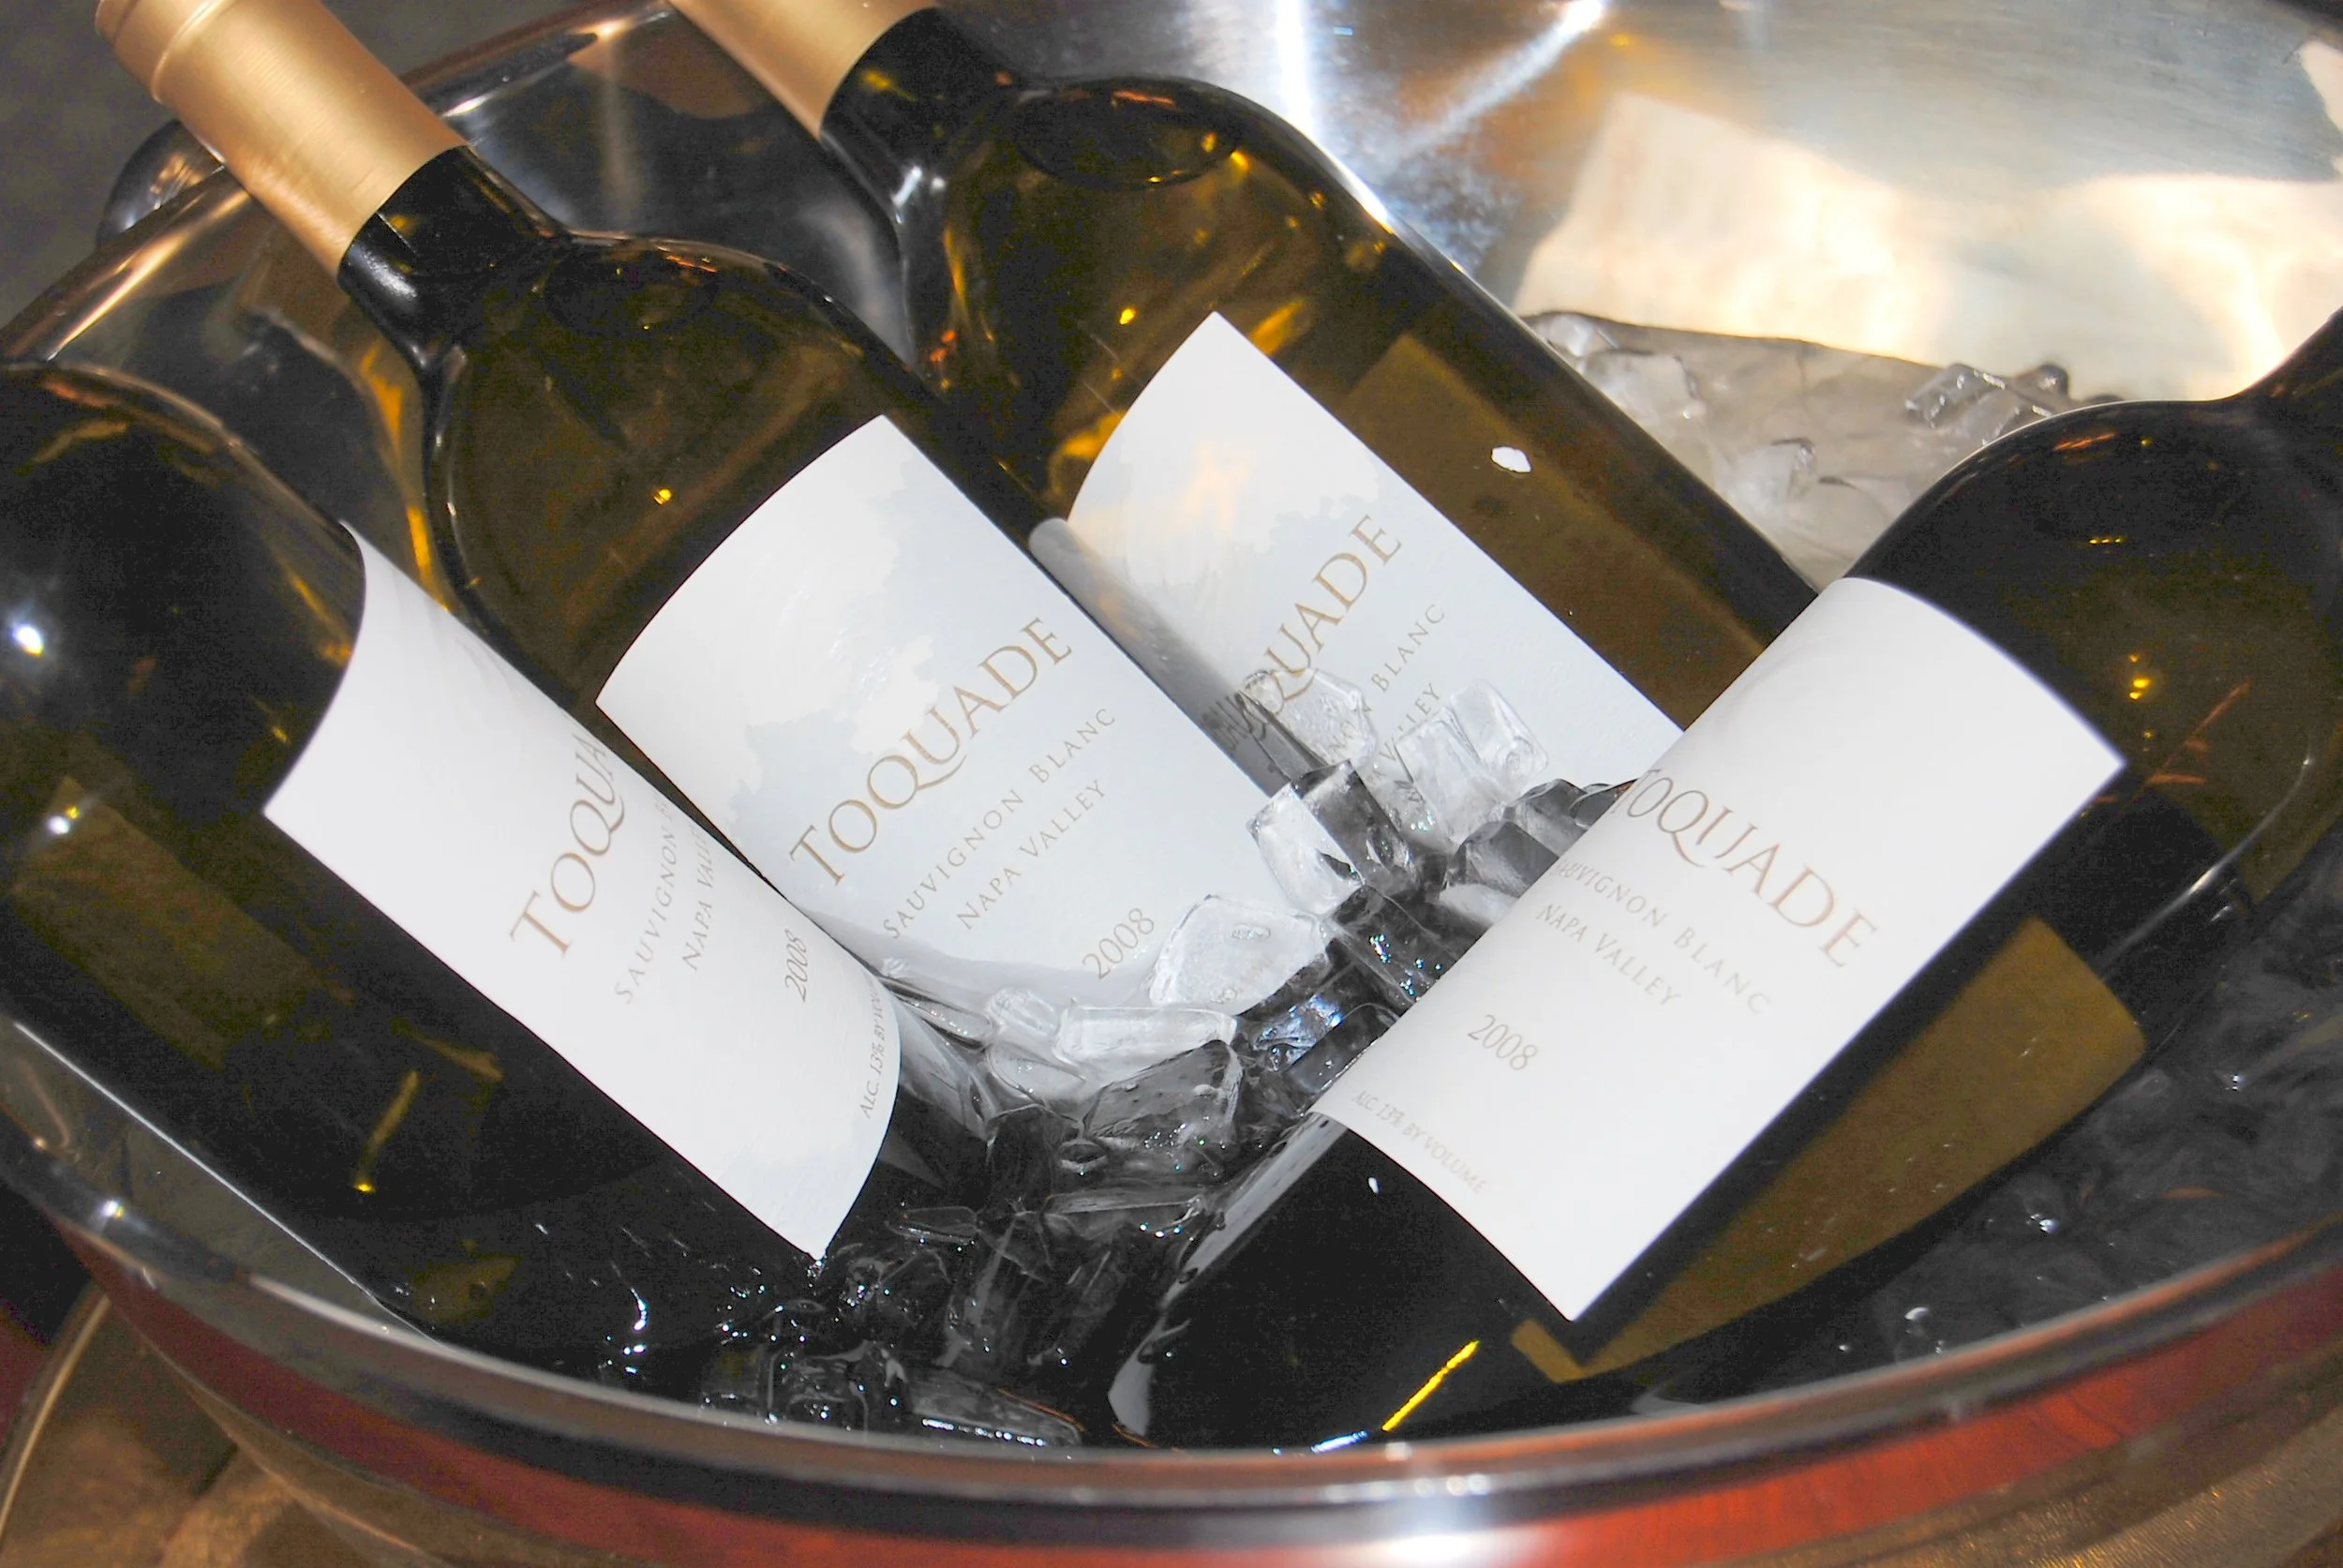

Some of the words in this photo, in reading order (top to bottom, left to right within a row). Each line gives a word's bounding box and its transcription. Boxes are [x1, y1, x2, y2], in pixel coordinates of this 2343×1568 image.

[1371, 604, 1445, 693] BLANC
[789, 617, 1073, 887] TOQUADE
[883, 788, 1024, 940] SAUVIGNON
[1028, 708, 1116, 784] BLANC
[956, 866, 1022, 931] NAPA
[1019, 779, 1106, 859] VALLEY
[615, 825, 678, 1004] SAUVIGNON
[681, 901, 714, 972] NAPA
[1082, 907, 1156, 980] 2008
[1535, 903, 1589, 945] NAPA
[1593, 933, 1682, 1008] VALLEY
[783, 929, 814, 1003] 2008
[1675, 925, 1771, 1016] BLANC
[1468, 1014, 1539, 1071] 2008
[1423, 1135, 1488, 1195] VOLUME
